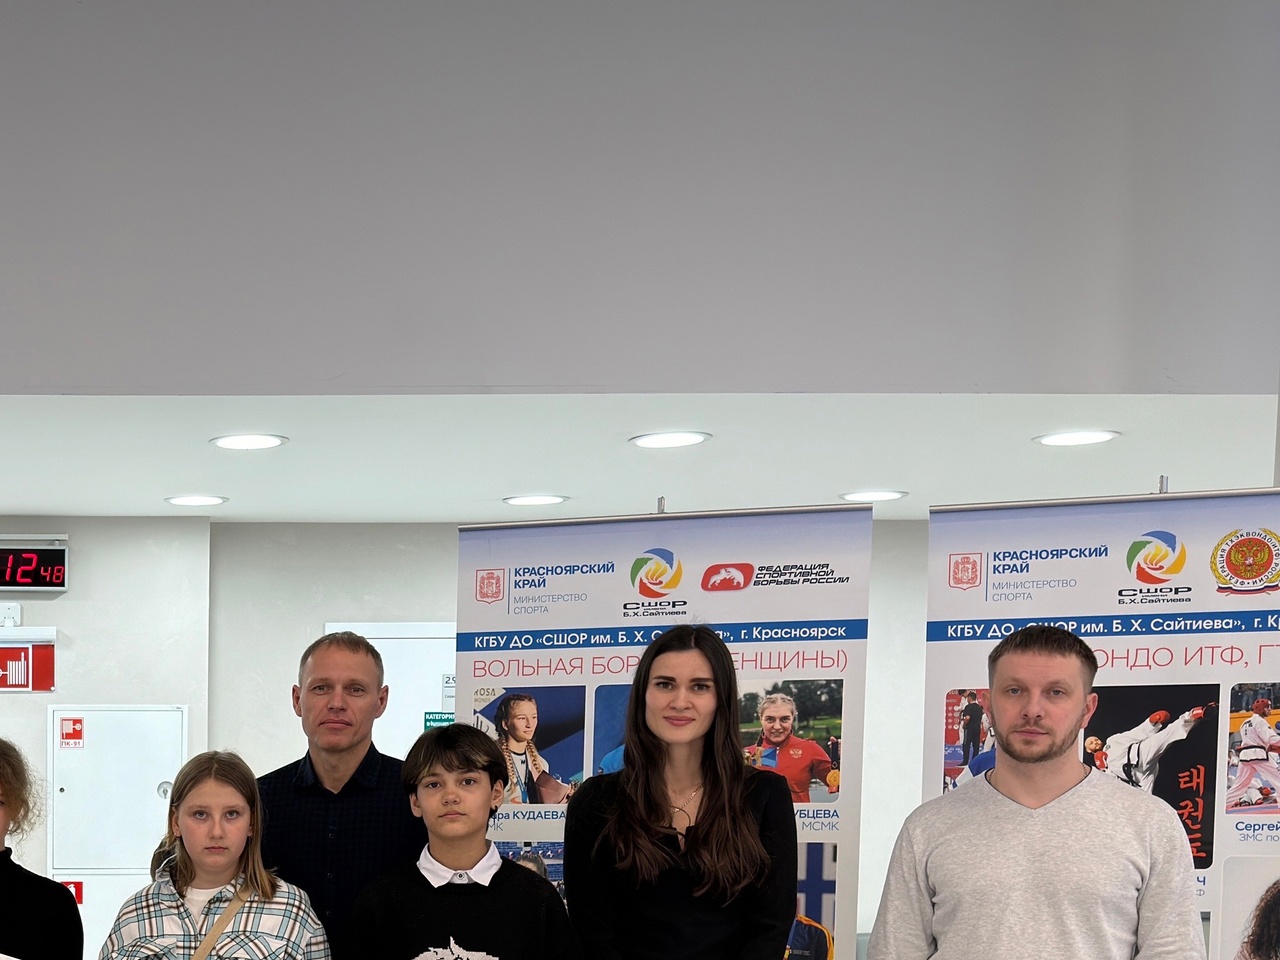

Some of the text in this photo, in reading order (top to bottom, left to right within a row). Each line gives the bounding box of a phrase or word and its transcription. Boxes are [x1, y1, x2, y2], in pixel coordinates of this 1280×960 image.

[992, 544, 1109, 563] КРАСНОЯРСКИЙ
[40, 565, 65, 583] 48
[513, 561, 615, 578] КРАСНОЯРСКИЙ
[755, 569, 835, 580] СПОРТИВНОЙ
[757, 563, 830, 573] ФЕДЕРАЦИЯ
[992, 560, 1030, 576] КРАЙ
[513, 577, 547, 590] КРАЙ
[752, 576, 850, 587] БОРЬБЫ РОССИИ
[992, 578, 1077, 590] МИНИСТЕРСТВО
[513, 592, 588, 605] МИНИСТЕРСТВО
[992, 591, 1033, 603] СПОРТА
[513, 606, 549, 616] СПОРТА
[947, 624, 985, 638] КГБУ
[987, 623, 1015, 638] ДО
[1080, 622, 1108, 634] им.
[1112, 619, 1126, 633] Б.
[1130, 618, 1146, 632] Х.
[1150, 616, 1246, 632] Сайтиева»,
[1253, 618, 1263, 629] г.
[474, 635, 508, 649] КГБУ
[509, 634, 533, 649] ДО
[536, 632, 588, 646] «СШОР
[590, 634, 614, 645] им.
[618, 631, 631, 644] Б.
[633, 630, 648, 643] Х.
[741, 629, 749, 640] г.
[752, 625, 847, 642] Красноярск
[1184, 645, 1249, 669] ИТФ,
[473, 656, 584, 679] ВОЛЬНАЯ
[511, 810, 566, 821] КУДАЕВА
[801, 821, 840, 831] МСМК
[1238, 833, 1263, 842] ЗМС
